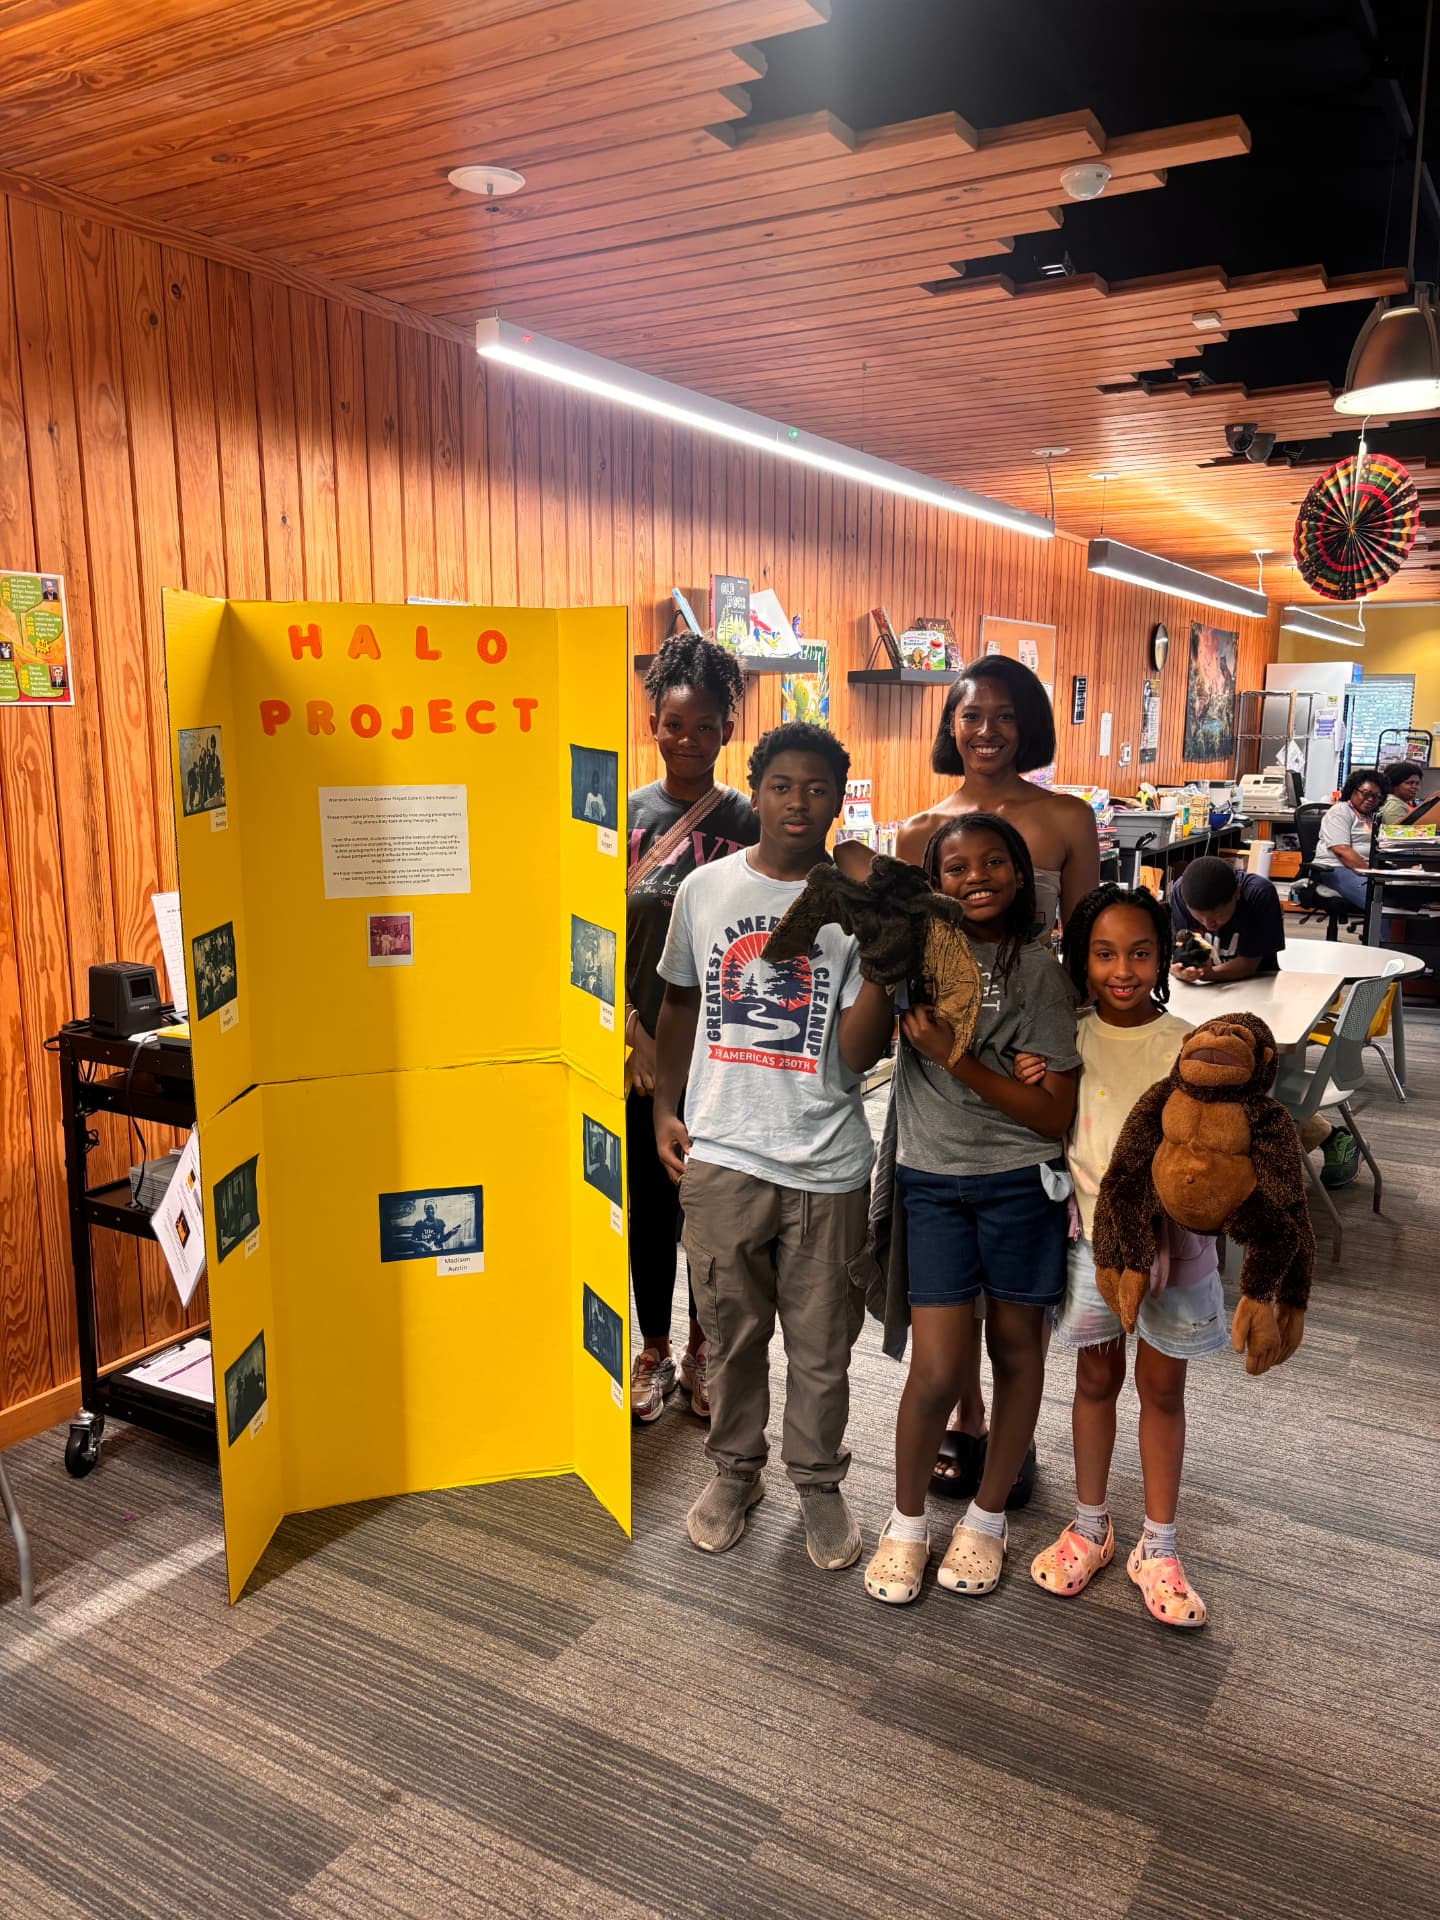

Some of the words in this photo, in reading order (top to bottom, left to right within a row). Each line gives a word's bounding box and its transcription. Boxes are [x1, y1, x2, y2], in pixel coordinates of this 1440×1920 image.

[287, 623, 508, 665] HALO
[259, 698, 539, 740] PROJECT
[706, 943, 724, 1042] GREATEST
[806, 967, 830, 1057] CLEANUP
[722, 1051, 776, 1066] AMERICA'S
[778, 1058, 811, 1071] 250TH
